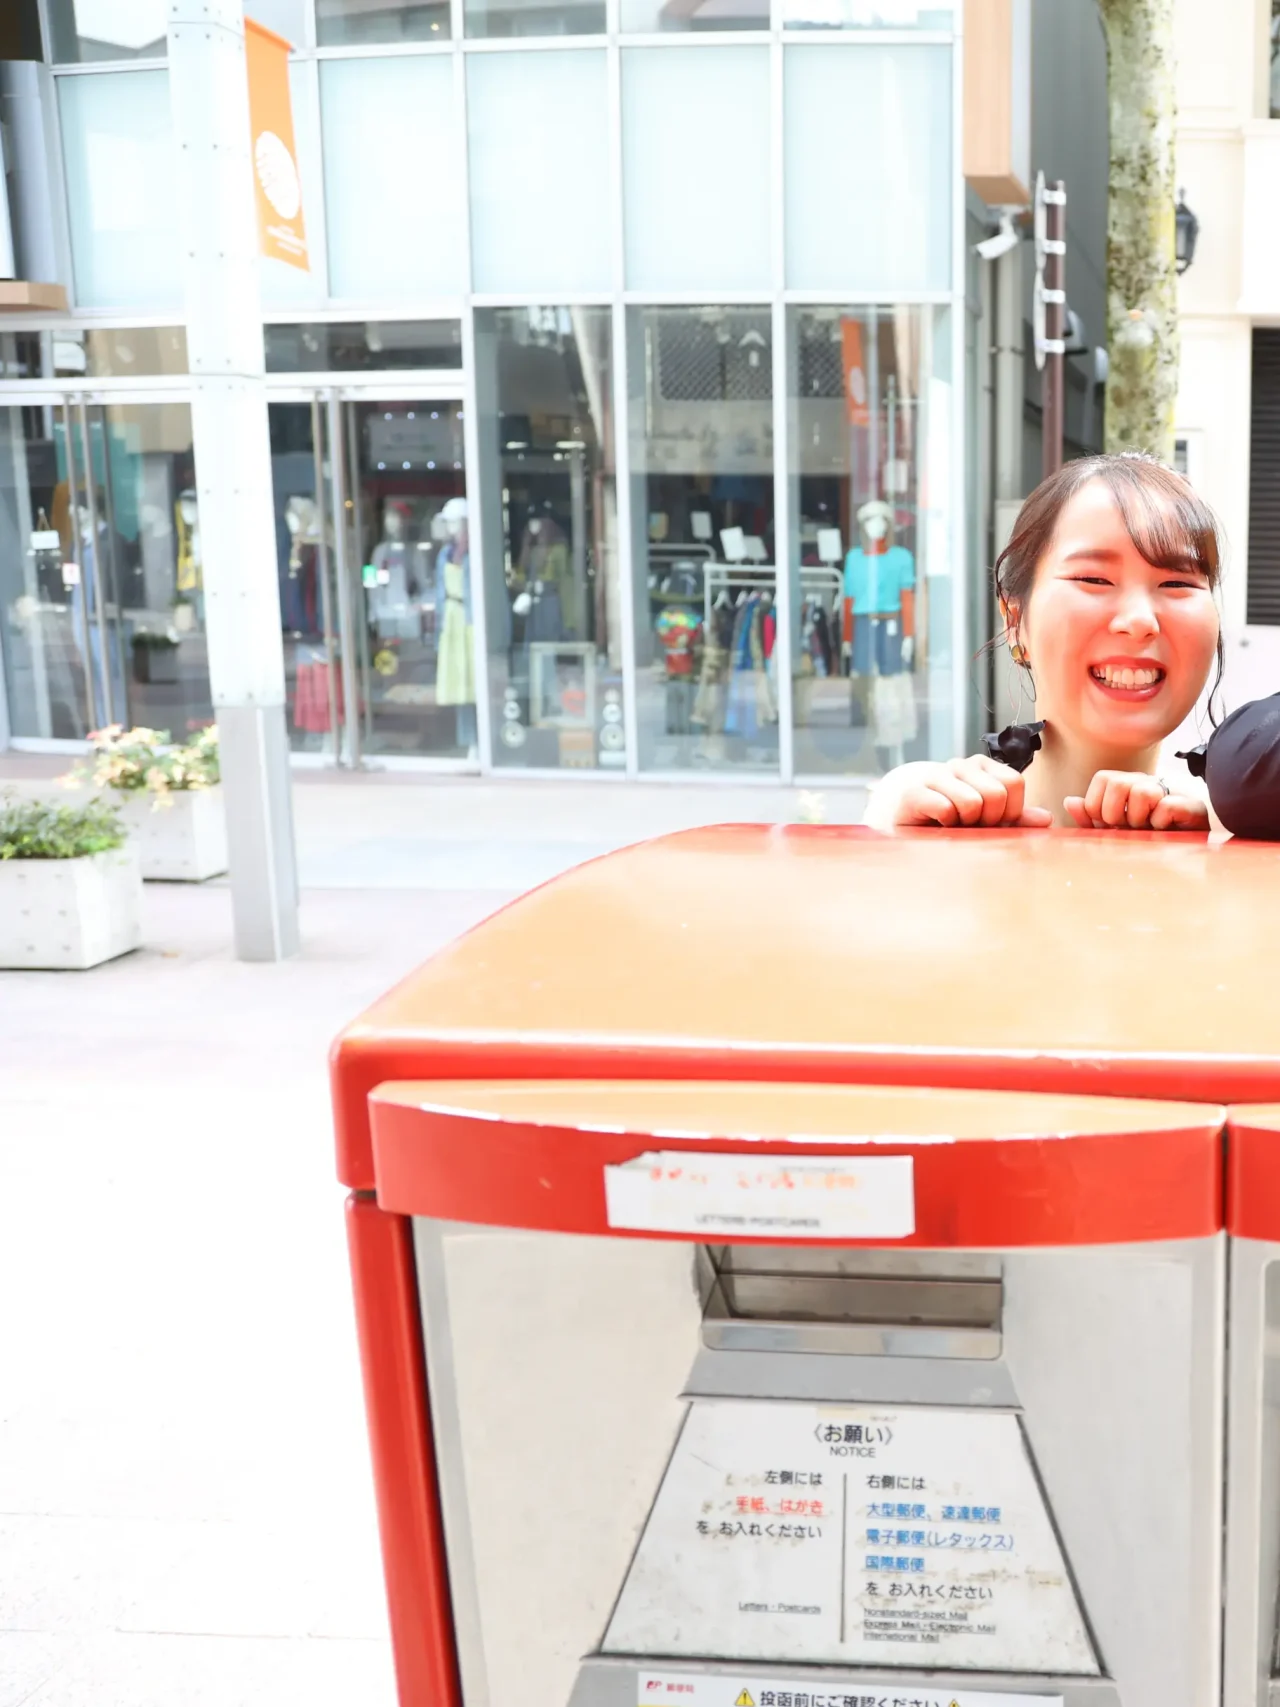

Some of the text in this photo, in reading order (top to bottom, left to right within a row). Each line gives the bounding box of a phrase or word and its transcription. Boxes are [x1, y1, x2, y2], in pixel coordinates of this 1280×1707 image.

[829, 1446, 876, 1458] NOTICE
[765, 1470, 823, 1486] 左側には
[866, 1474, 926, 1490] 右側には
